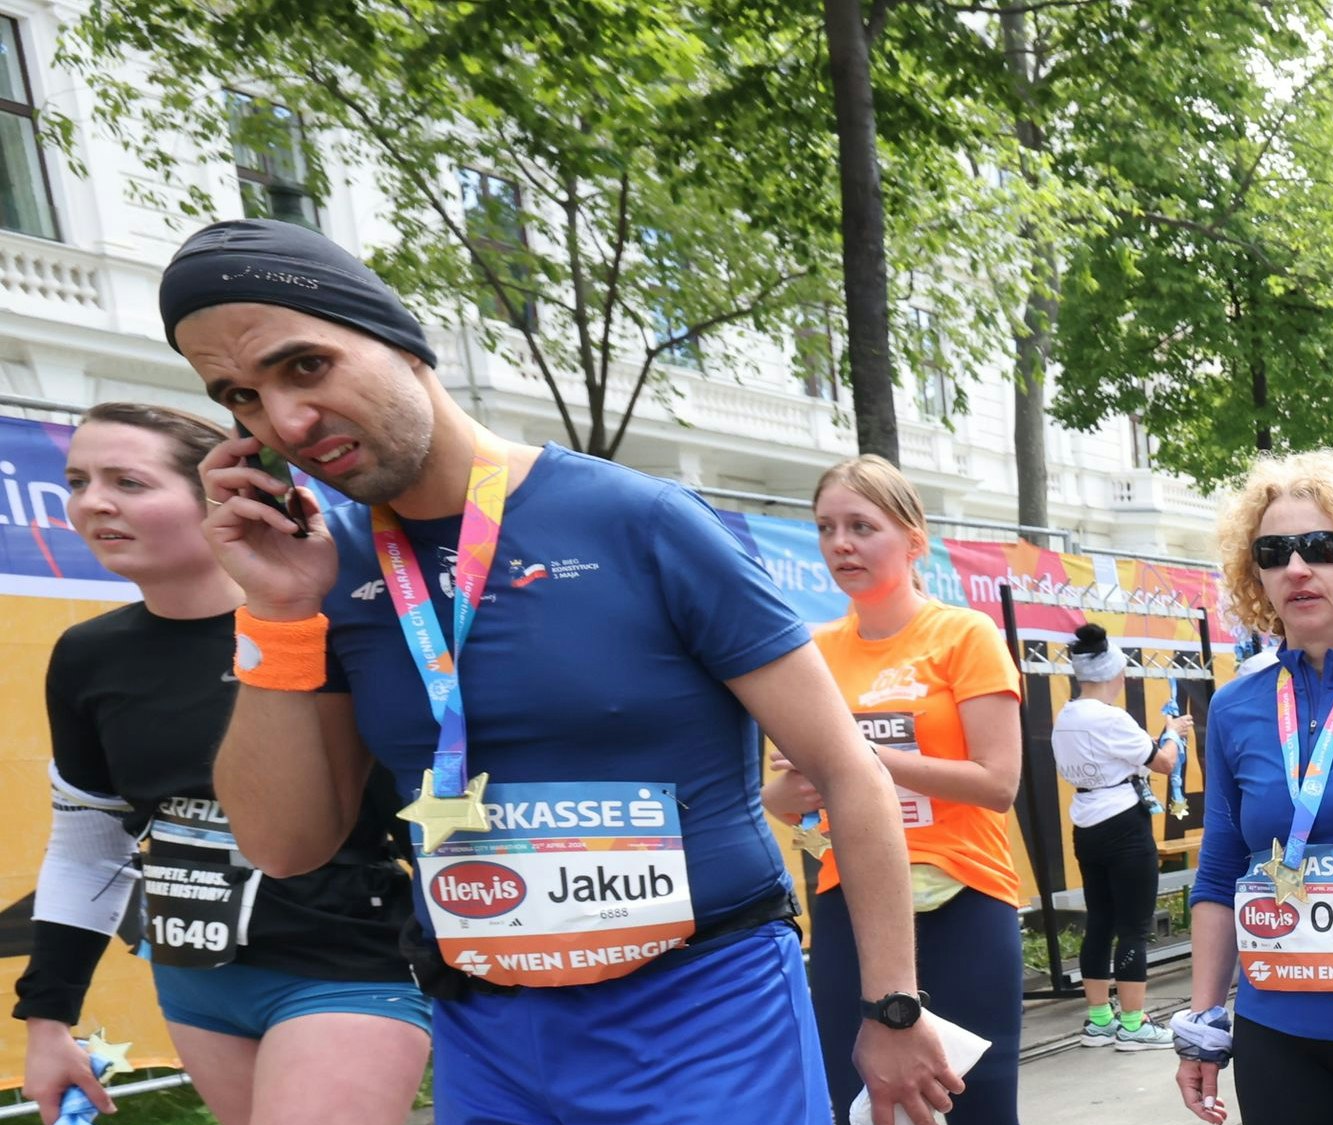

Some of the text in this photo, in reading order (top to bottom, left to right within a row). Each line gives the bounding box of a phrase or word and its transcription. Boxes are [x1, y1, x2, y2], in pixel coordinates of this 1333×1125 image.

[923, 563, 963, 601] cht
[387, 543, 441, 672] VIENNA CITY MARATHON
[857, 718, 906, 739] ADE
[486, 800, 625, 830] RKASSE
[439, 875, 519, 906] Hervis
[548, 865, 675, 904] Jakub
[1245, 906, 1294, 930] Hervis
[151, 915, 229, 952] 1649
[495, 951, 565, 972] WIEN
[1275, 965, 1315, 980] WIEN
